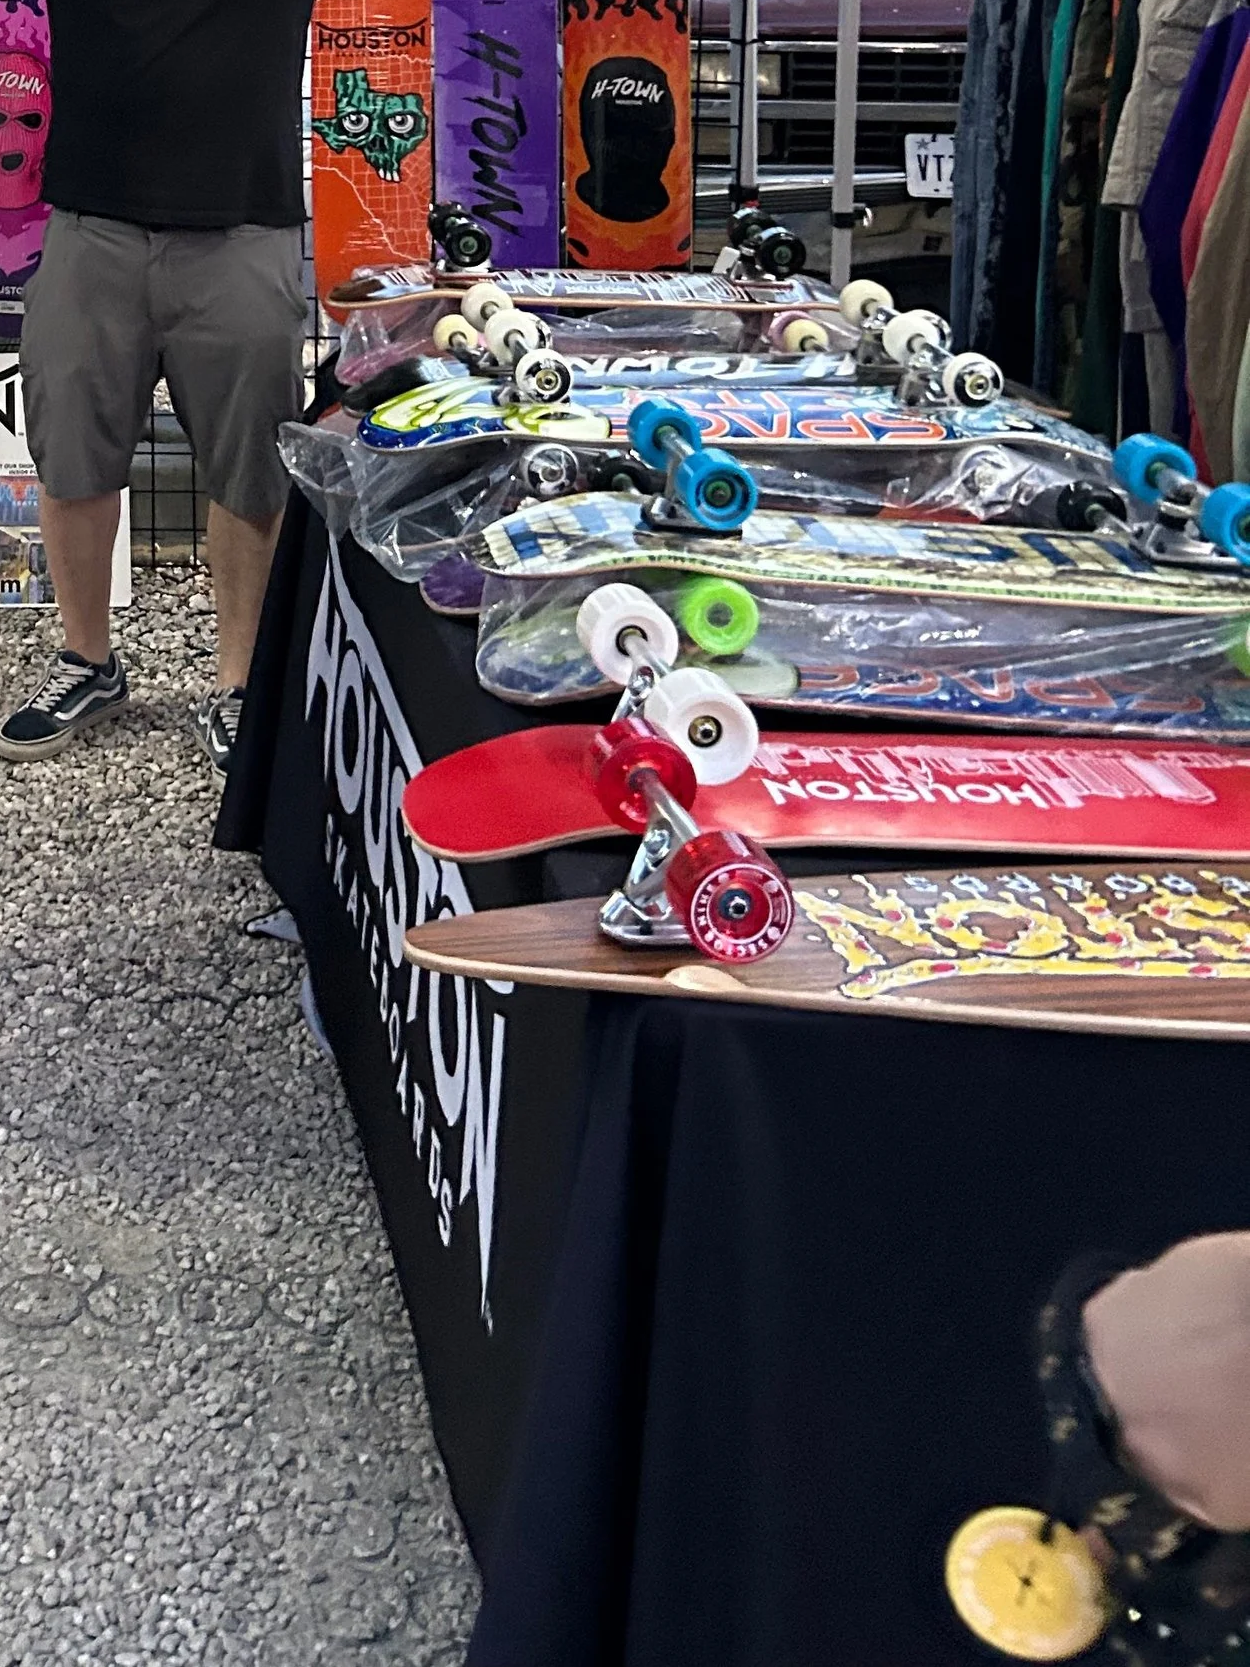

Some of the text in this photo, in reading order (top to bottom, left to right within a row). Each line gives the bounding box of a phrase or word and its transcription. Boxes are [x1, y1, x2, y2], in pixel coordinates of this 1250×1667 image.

[315, 17, 427, 51] HOUSTON
[591, 76, 665, 104] H-TOWN
[453, 30, 528, 239] H-TOWN
[764, 776, 1050, 809] HOUSTON
[324, 811, 453, 1250] SKATEBOARDS
